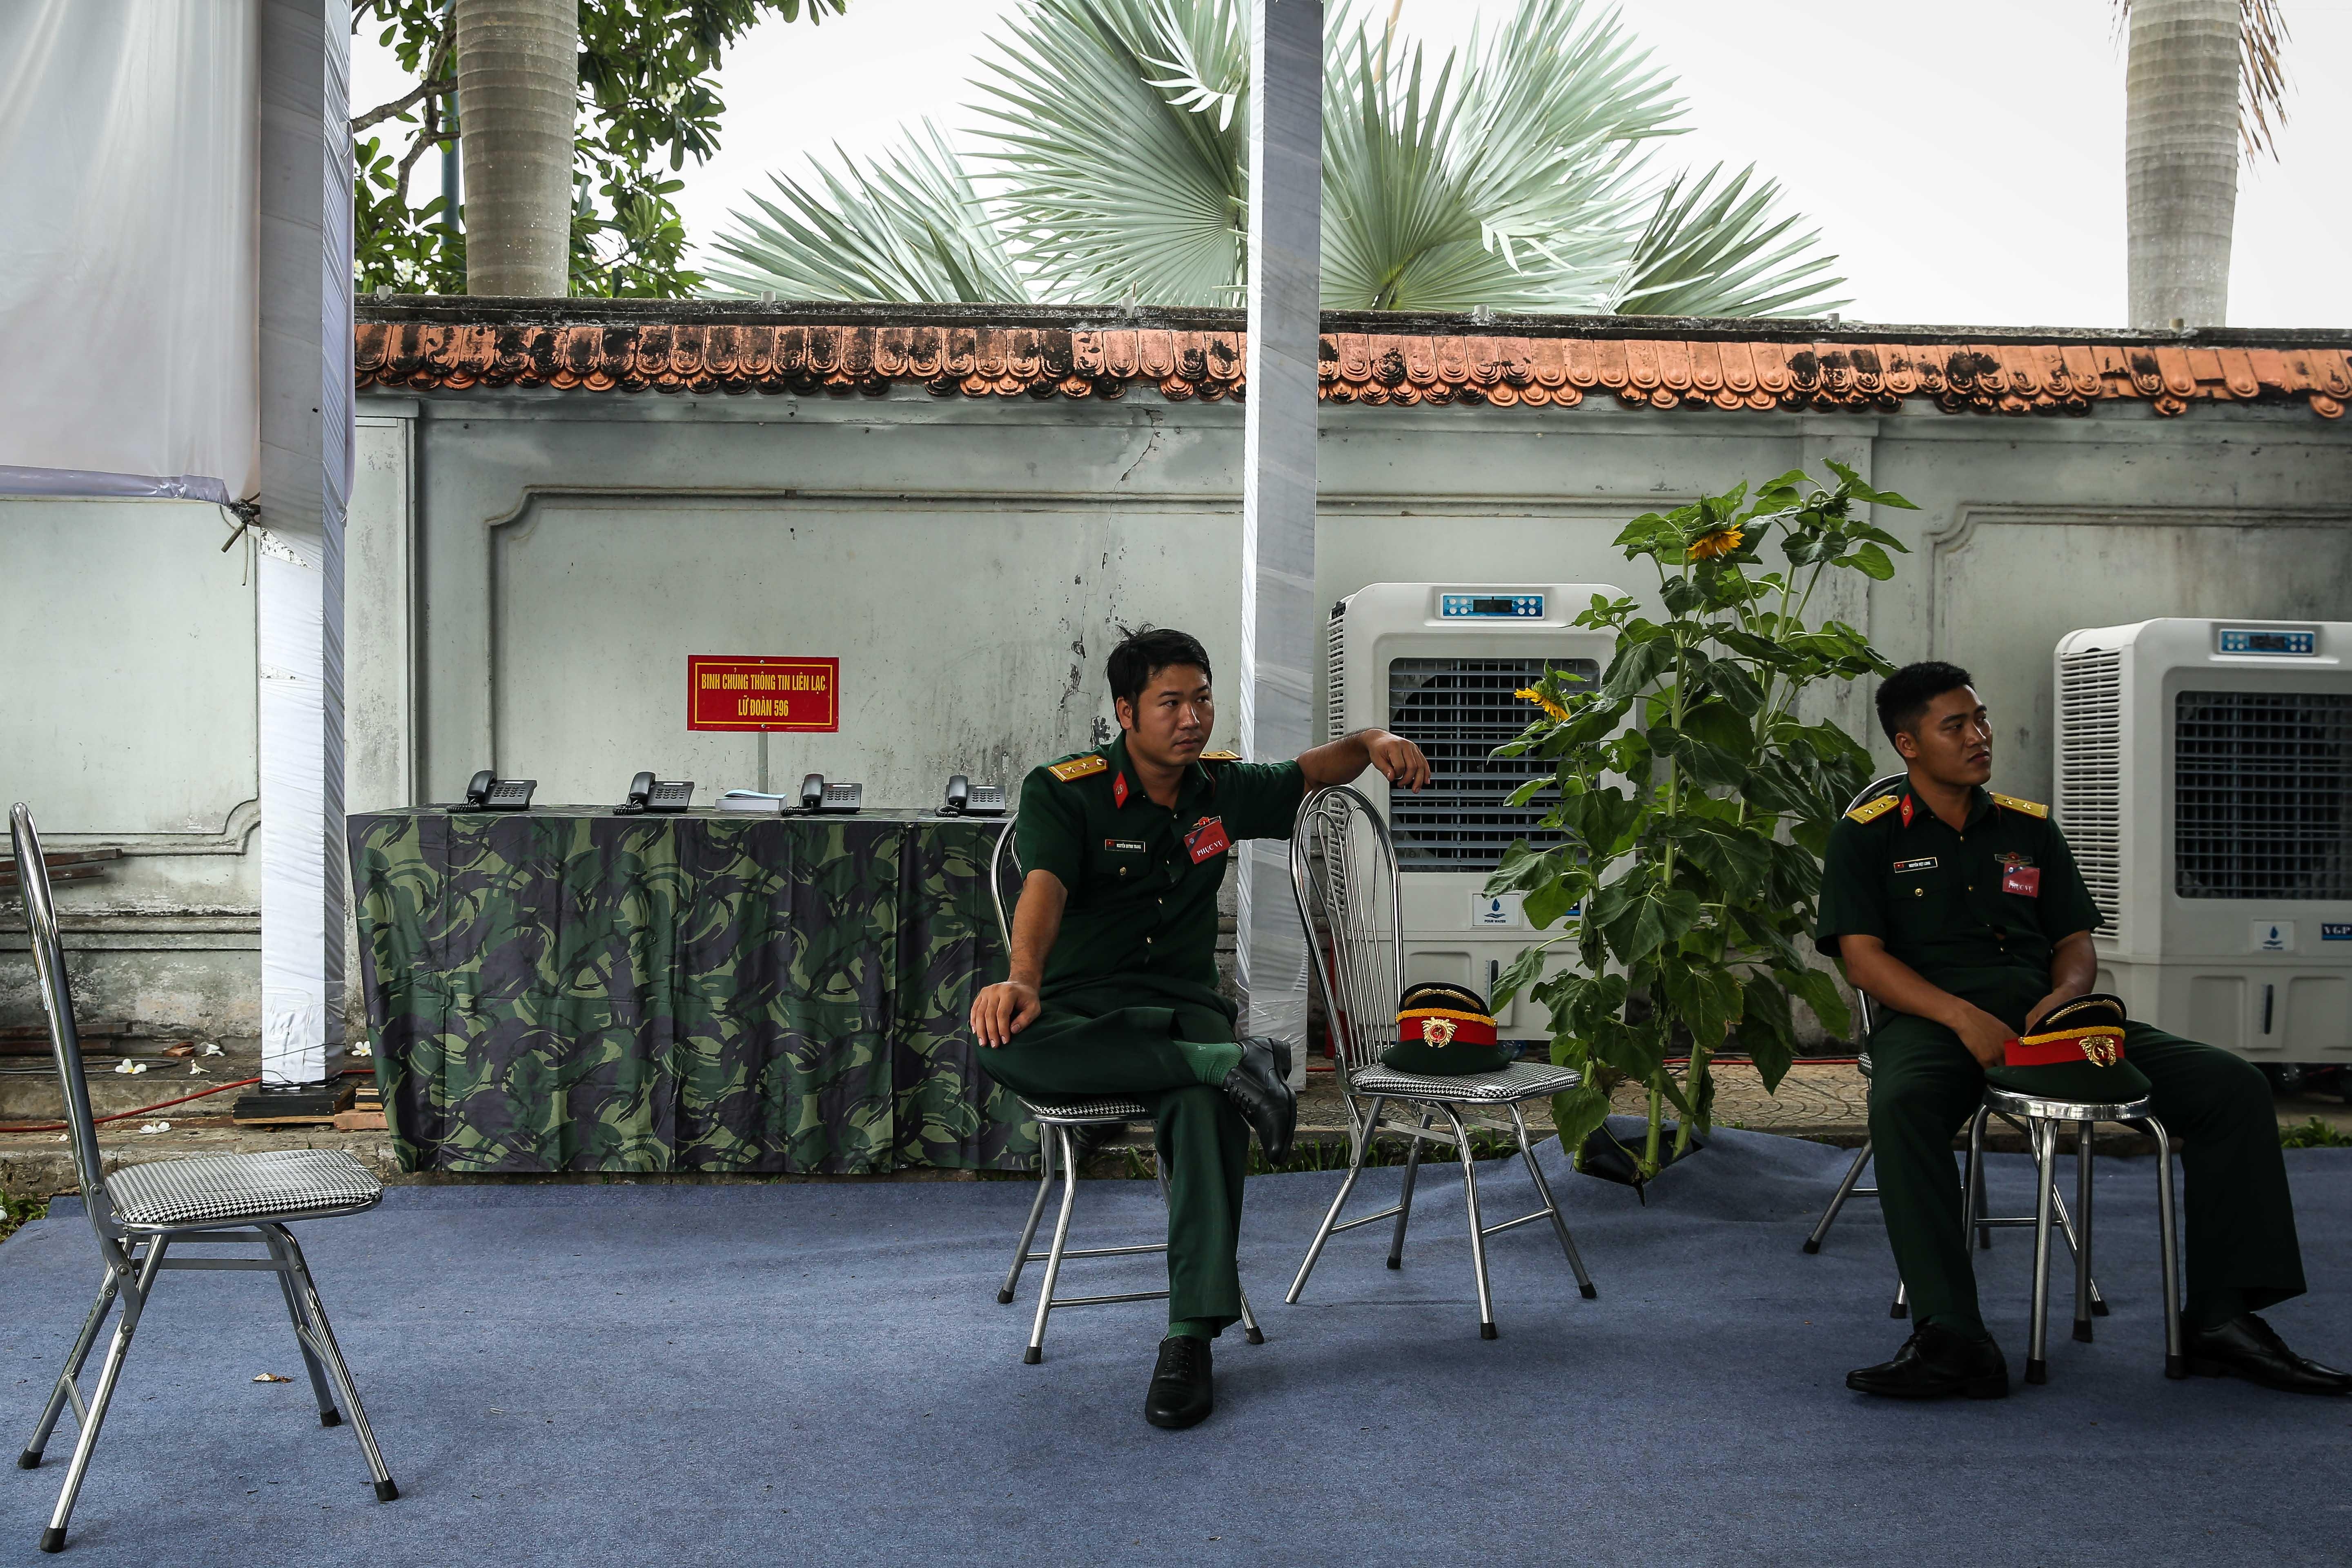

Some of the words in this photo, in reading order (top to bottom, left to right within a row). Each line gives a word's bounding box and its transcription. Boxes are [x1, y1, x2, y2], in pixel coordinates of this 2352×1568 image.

[702, 674, 720, 689] BINH
[722, 668, 748, 690] CHỦNG
[751, 671, 775, 690] THÔNG
[778, 675, 790, 690] TIN
[792, 672, 809, 691] LIÊN
[811, 675, 826, 694] LẠC
[738, 695, 749, 716] LỮ
[750, 696, 772, 716] ĐOÀN
[774, 700, 788, 717] 596
[1196, 844, 1214, 856] PHỤC
